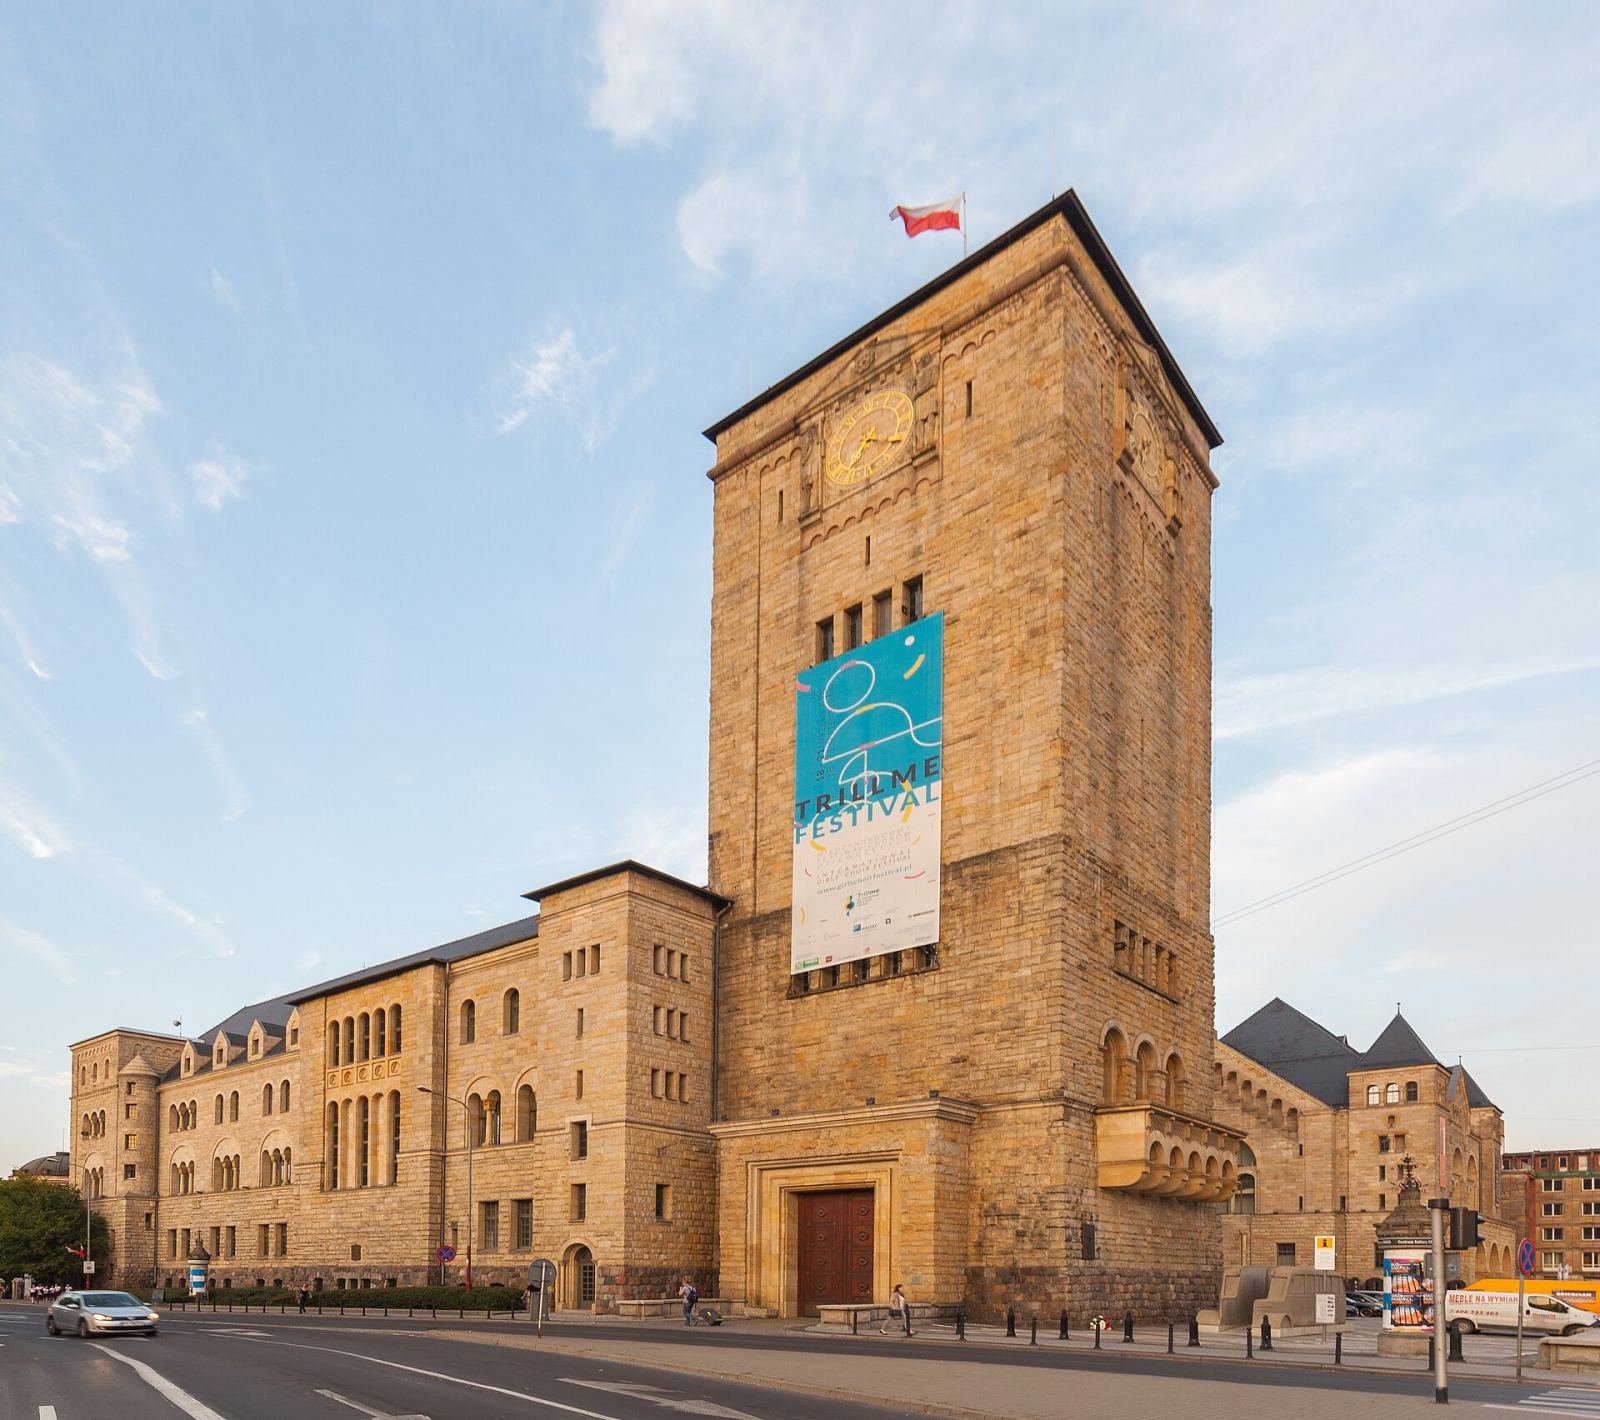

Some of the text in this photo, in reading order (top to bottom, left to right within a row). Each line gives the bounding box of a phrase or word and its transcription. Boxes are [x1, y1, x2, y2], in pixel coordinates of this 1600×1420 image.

[794, 784, 940, 845] FESTIVAL
[795, 755, 940, 820] TRILLME
[1448, 1294, 1473, 1303] MEBLE
[1475, 1295, 1486, 1303] NA
